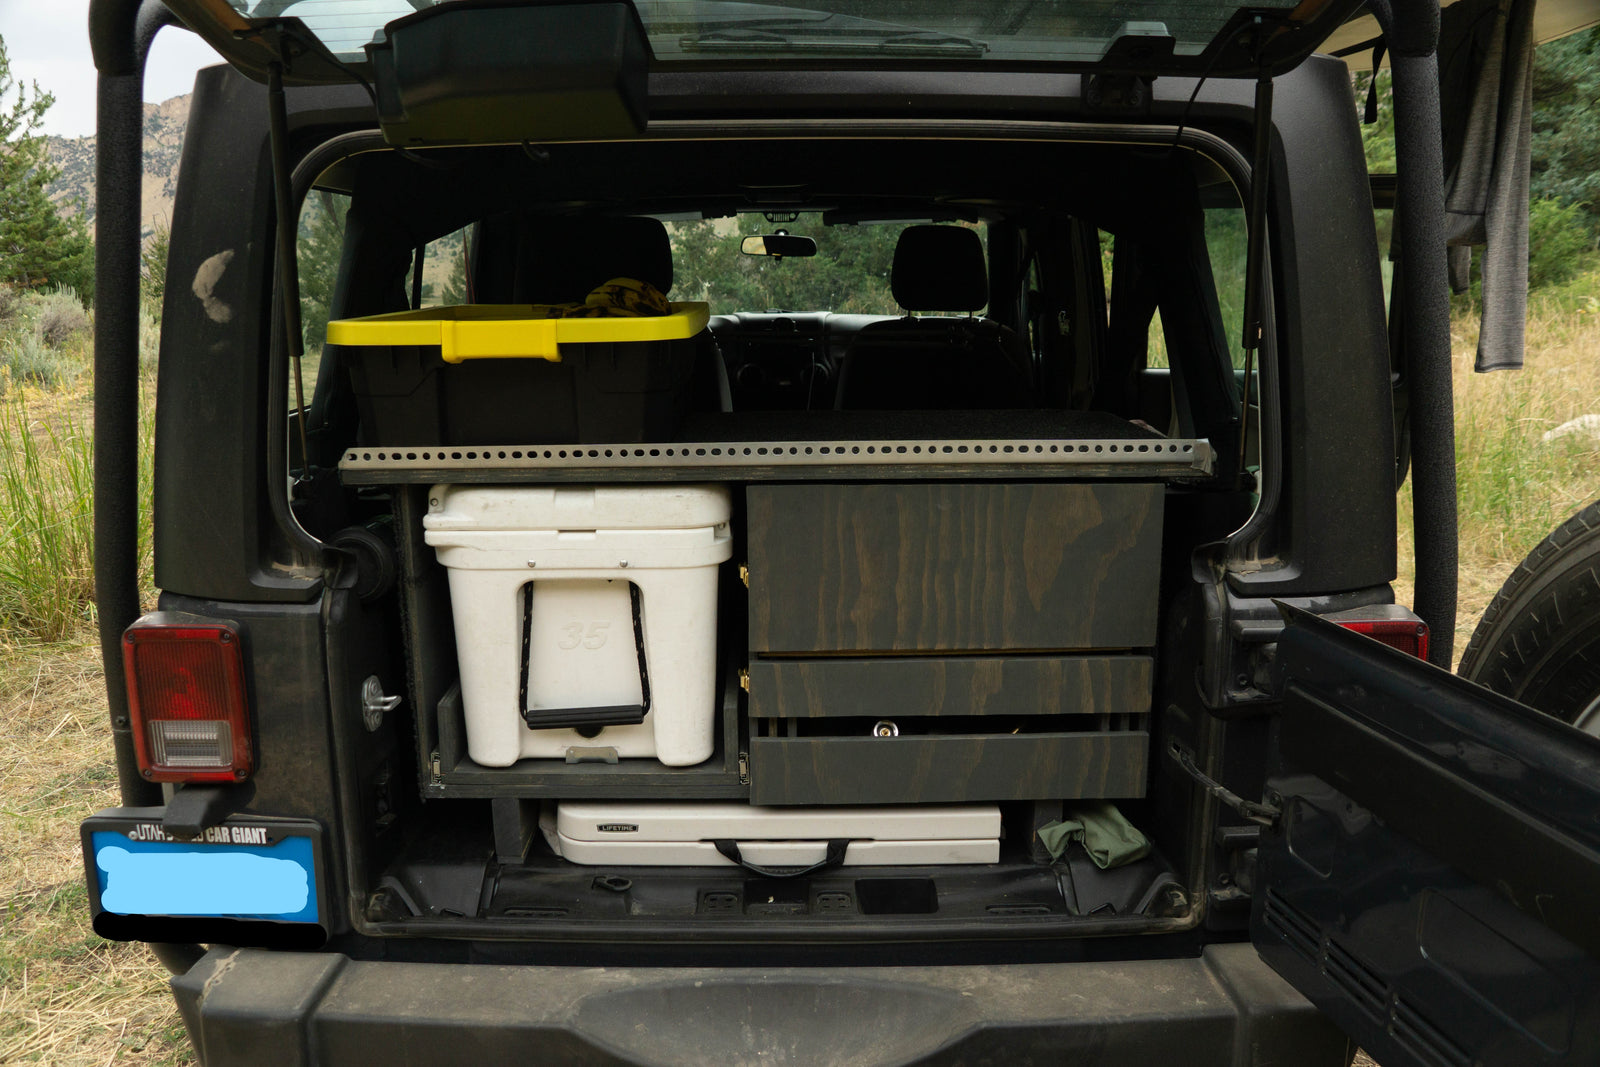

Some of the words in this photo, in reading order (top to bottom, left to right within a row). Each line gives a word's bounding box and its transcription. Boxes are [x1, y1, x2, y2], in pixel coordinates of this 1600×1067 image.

[557, 621, 611, 651] 35
[205, 826, 231, 843] CAR
[231, 826, 267, 844] GIANT
